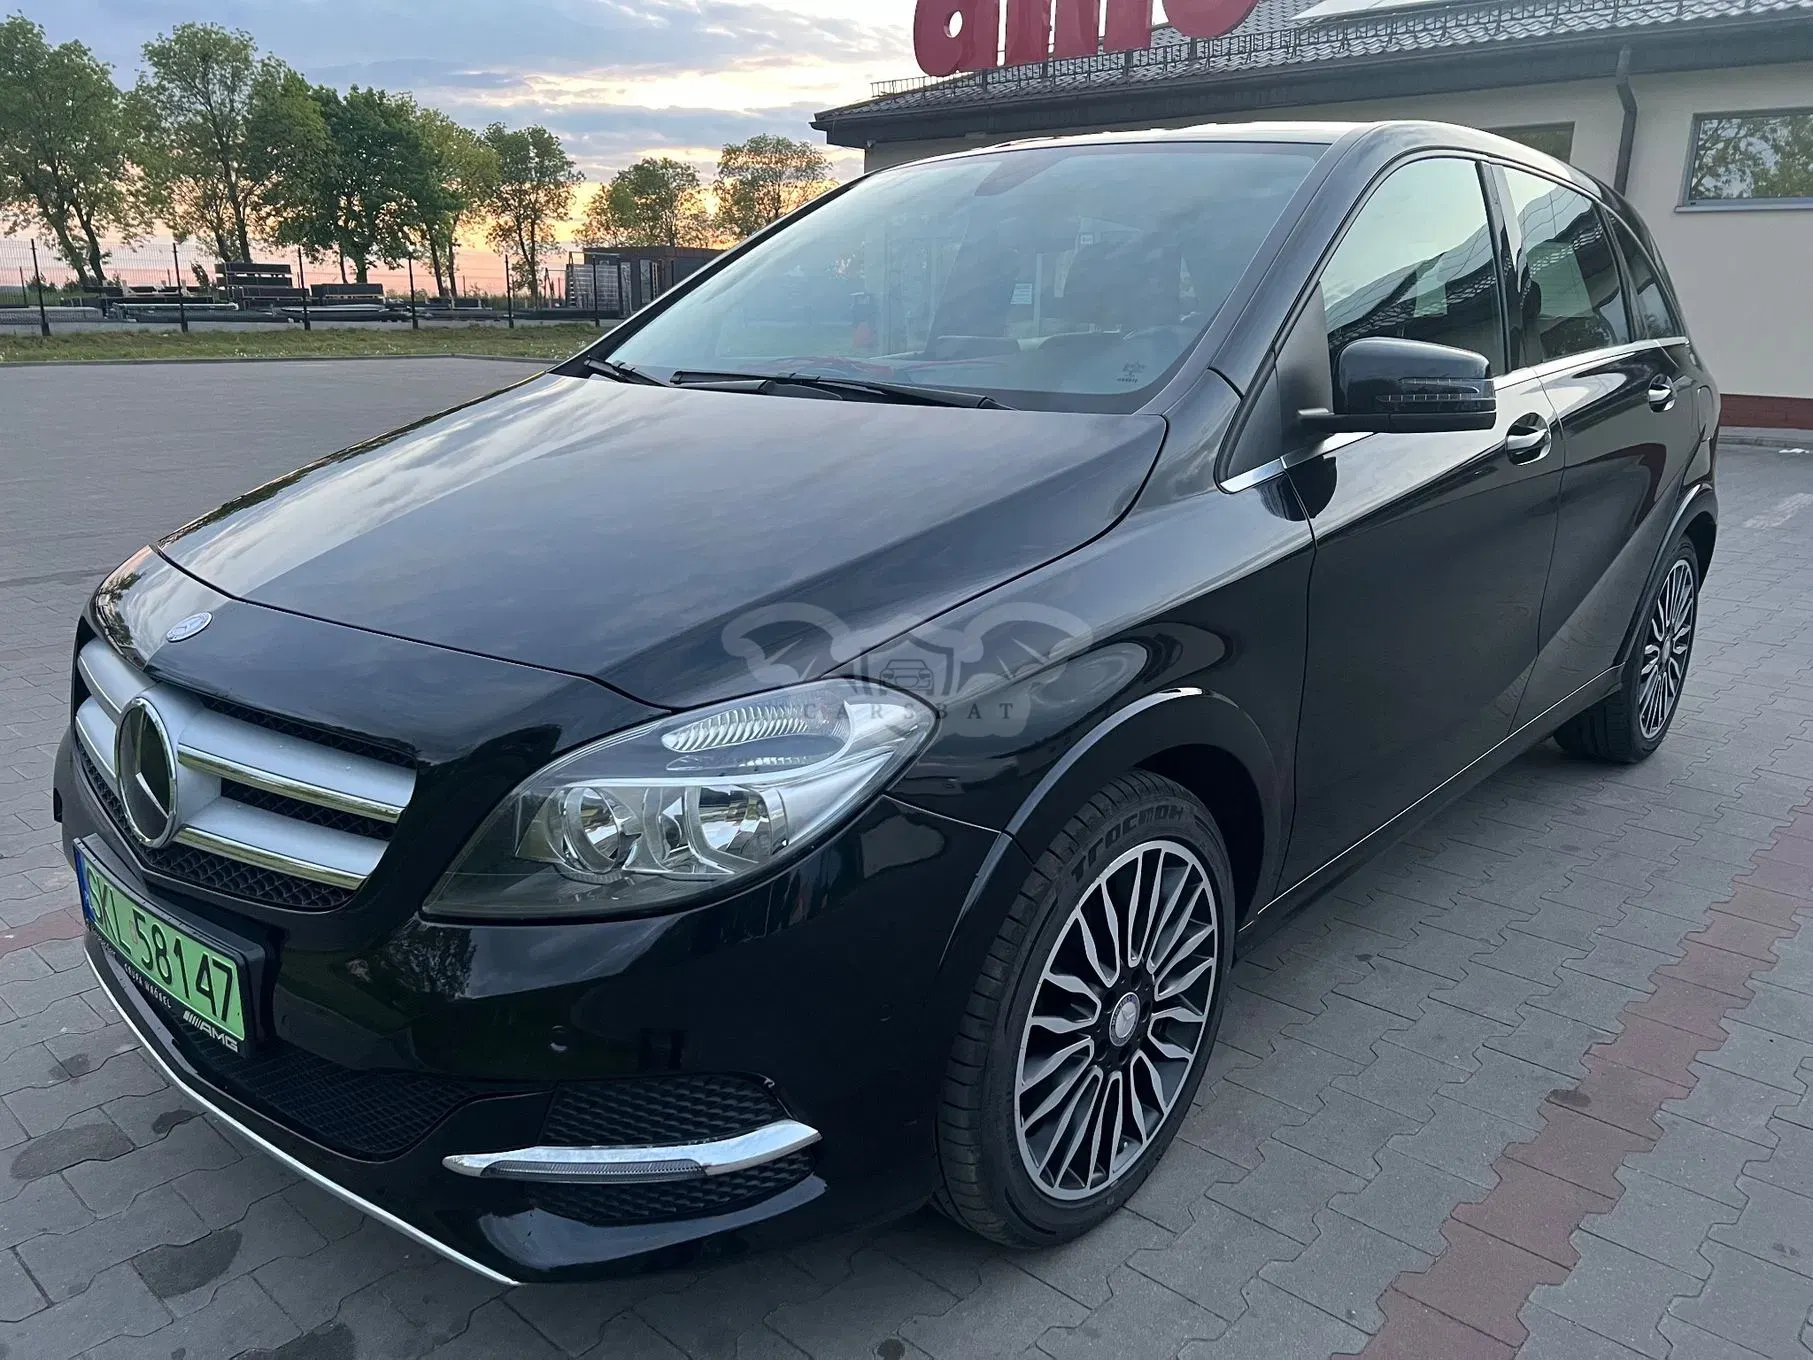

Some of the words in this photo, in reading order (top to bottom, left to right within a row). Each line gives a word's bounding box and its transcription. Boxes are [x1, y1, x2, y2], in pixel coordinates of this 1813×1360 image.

[87, 865, 131, 954] SKL
[132, 908, 234, 1023] 58147
[196, 1016, 239, 1053] AMG
